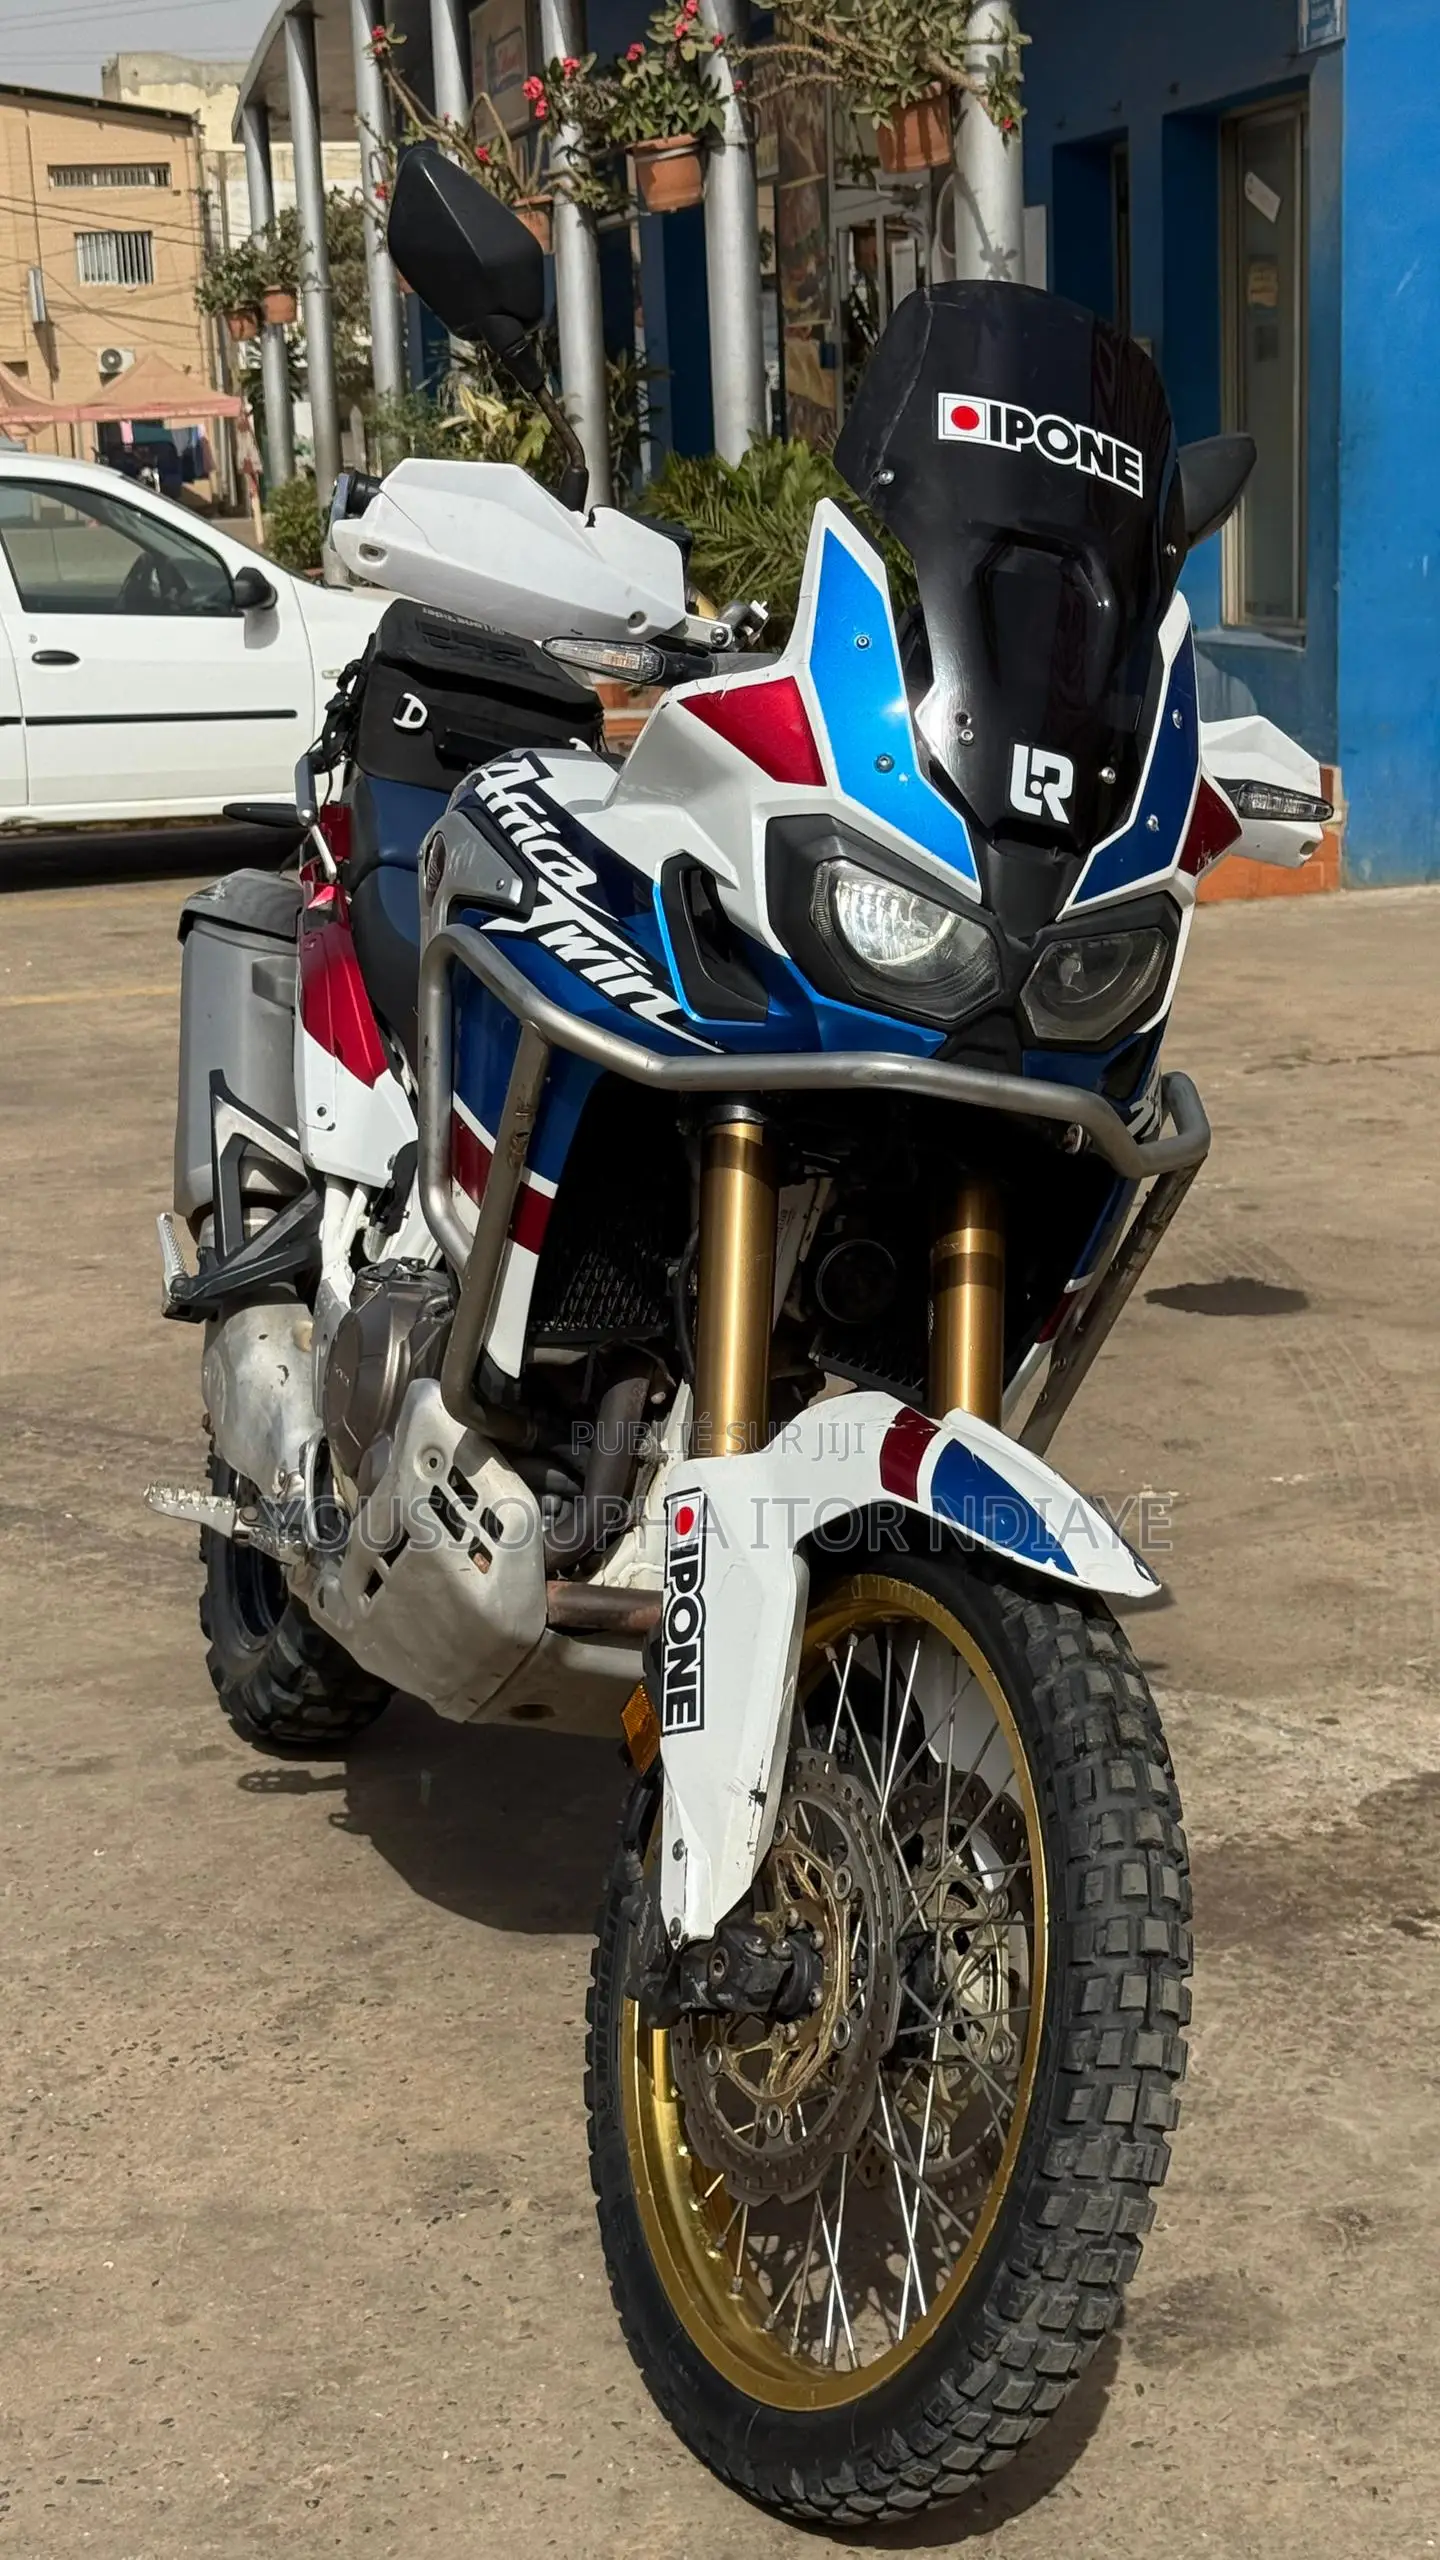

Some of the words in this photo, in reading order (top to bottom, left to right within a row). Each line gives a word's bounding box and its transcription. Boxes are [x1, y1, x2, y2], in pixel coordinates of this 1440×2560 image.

[988, 403, 1141, 493] IPONE
[475, 758, 619, 921] Africa
[480, 877, 725, 1053] Twin
[666, 1540, 700, 1728] IPONE
